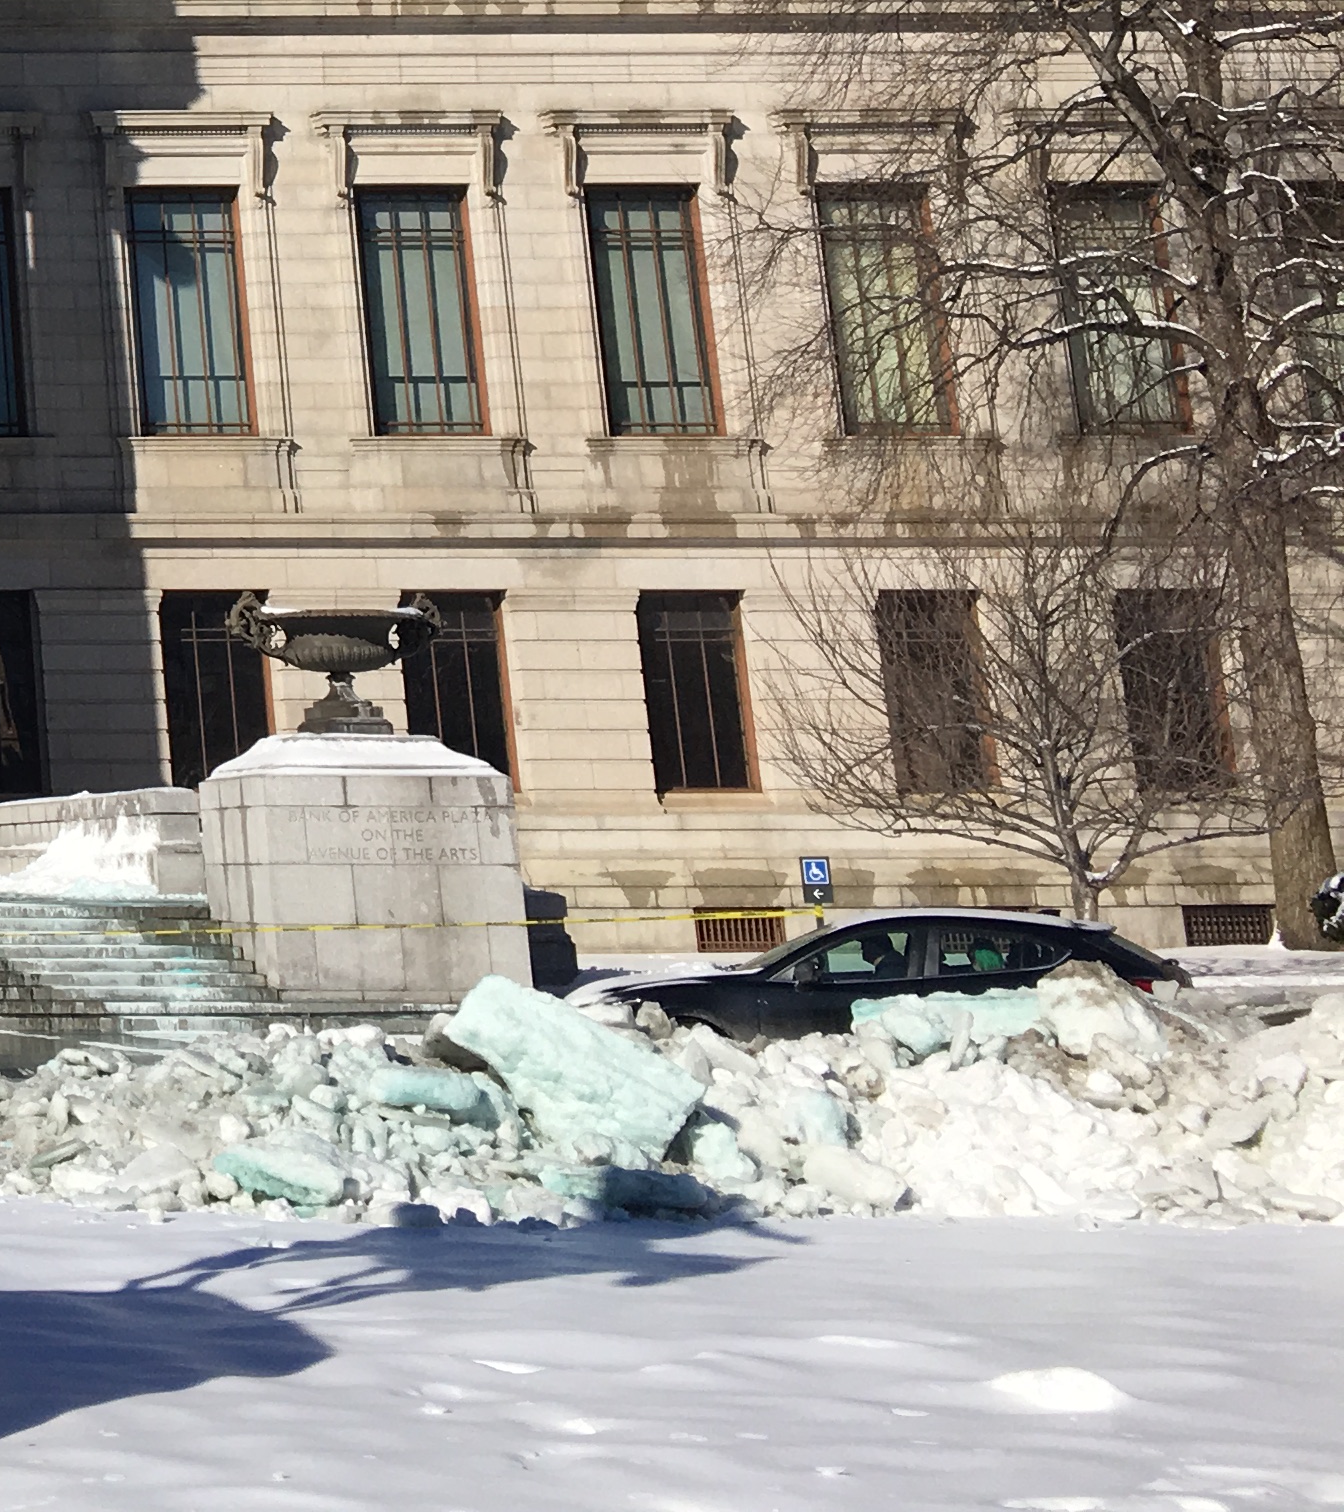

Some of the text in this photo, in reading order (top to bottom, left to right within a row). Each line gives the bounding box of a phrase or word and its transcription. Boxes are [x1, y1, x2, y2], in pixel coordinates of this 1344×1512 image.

[288, 809, 492, 823] BANK OF AMERICA PLAZA
[361, 828, 424, 842] ON THE
[310, 847, 478, 861] AVENUE OF THE ARTS
